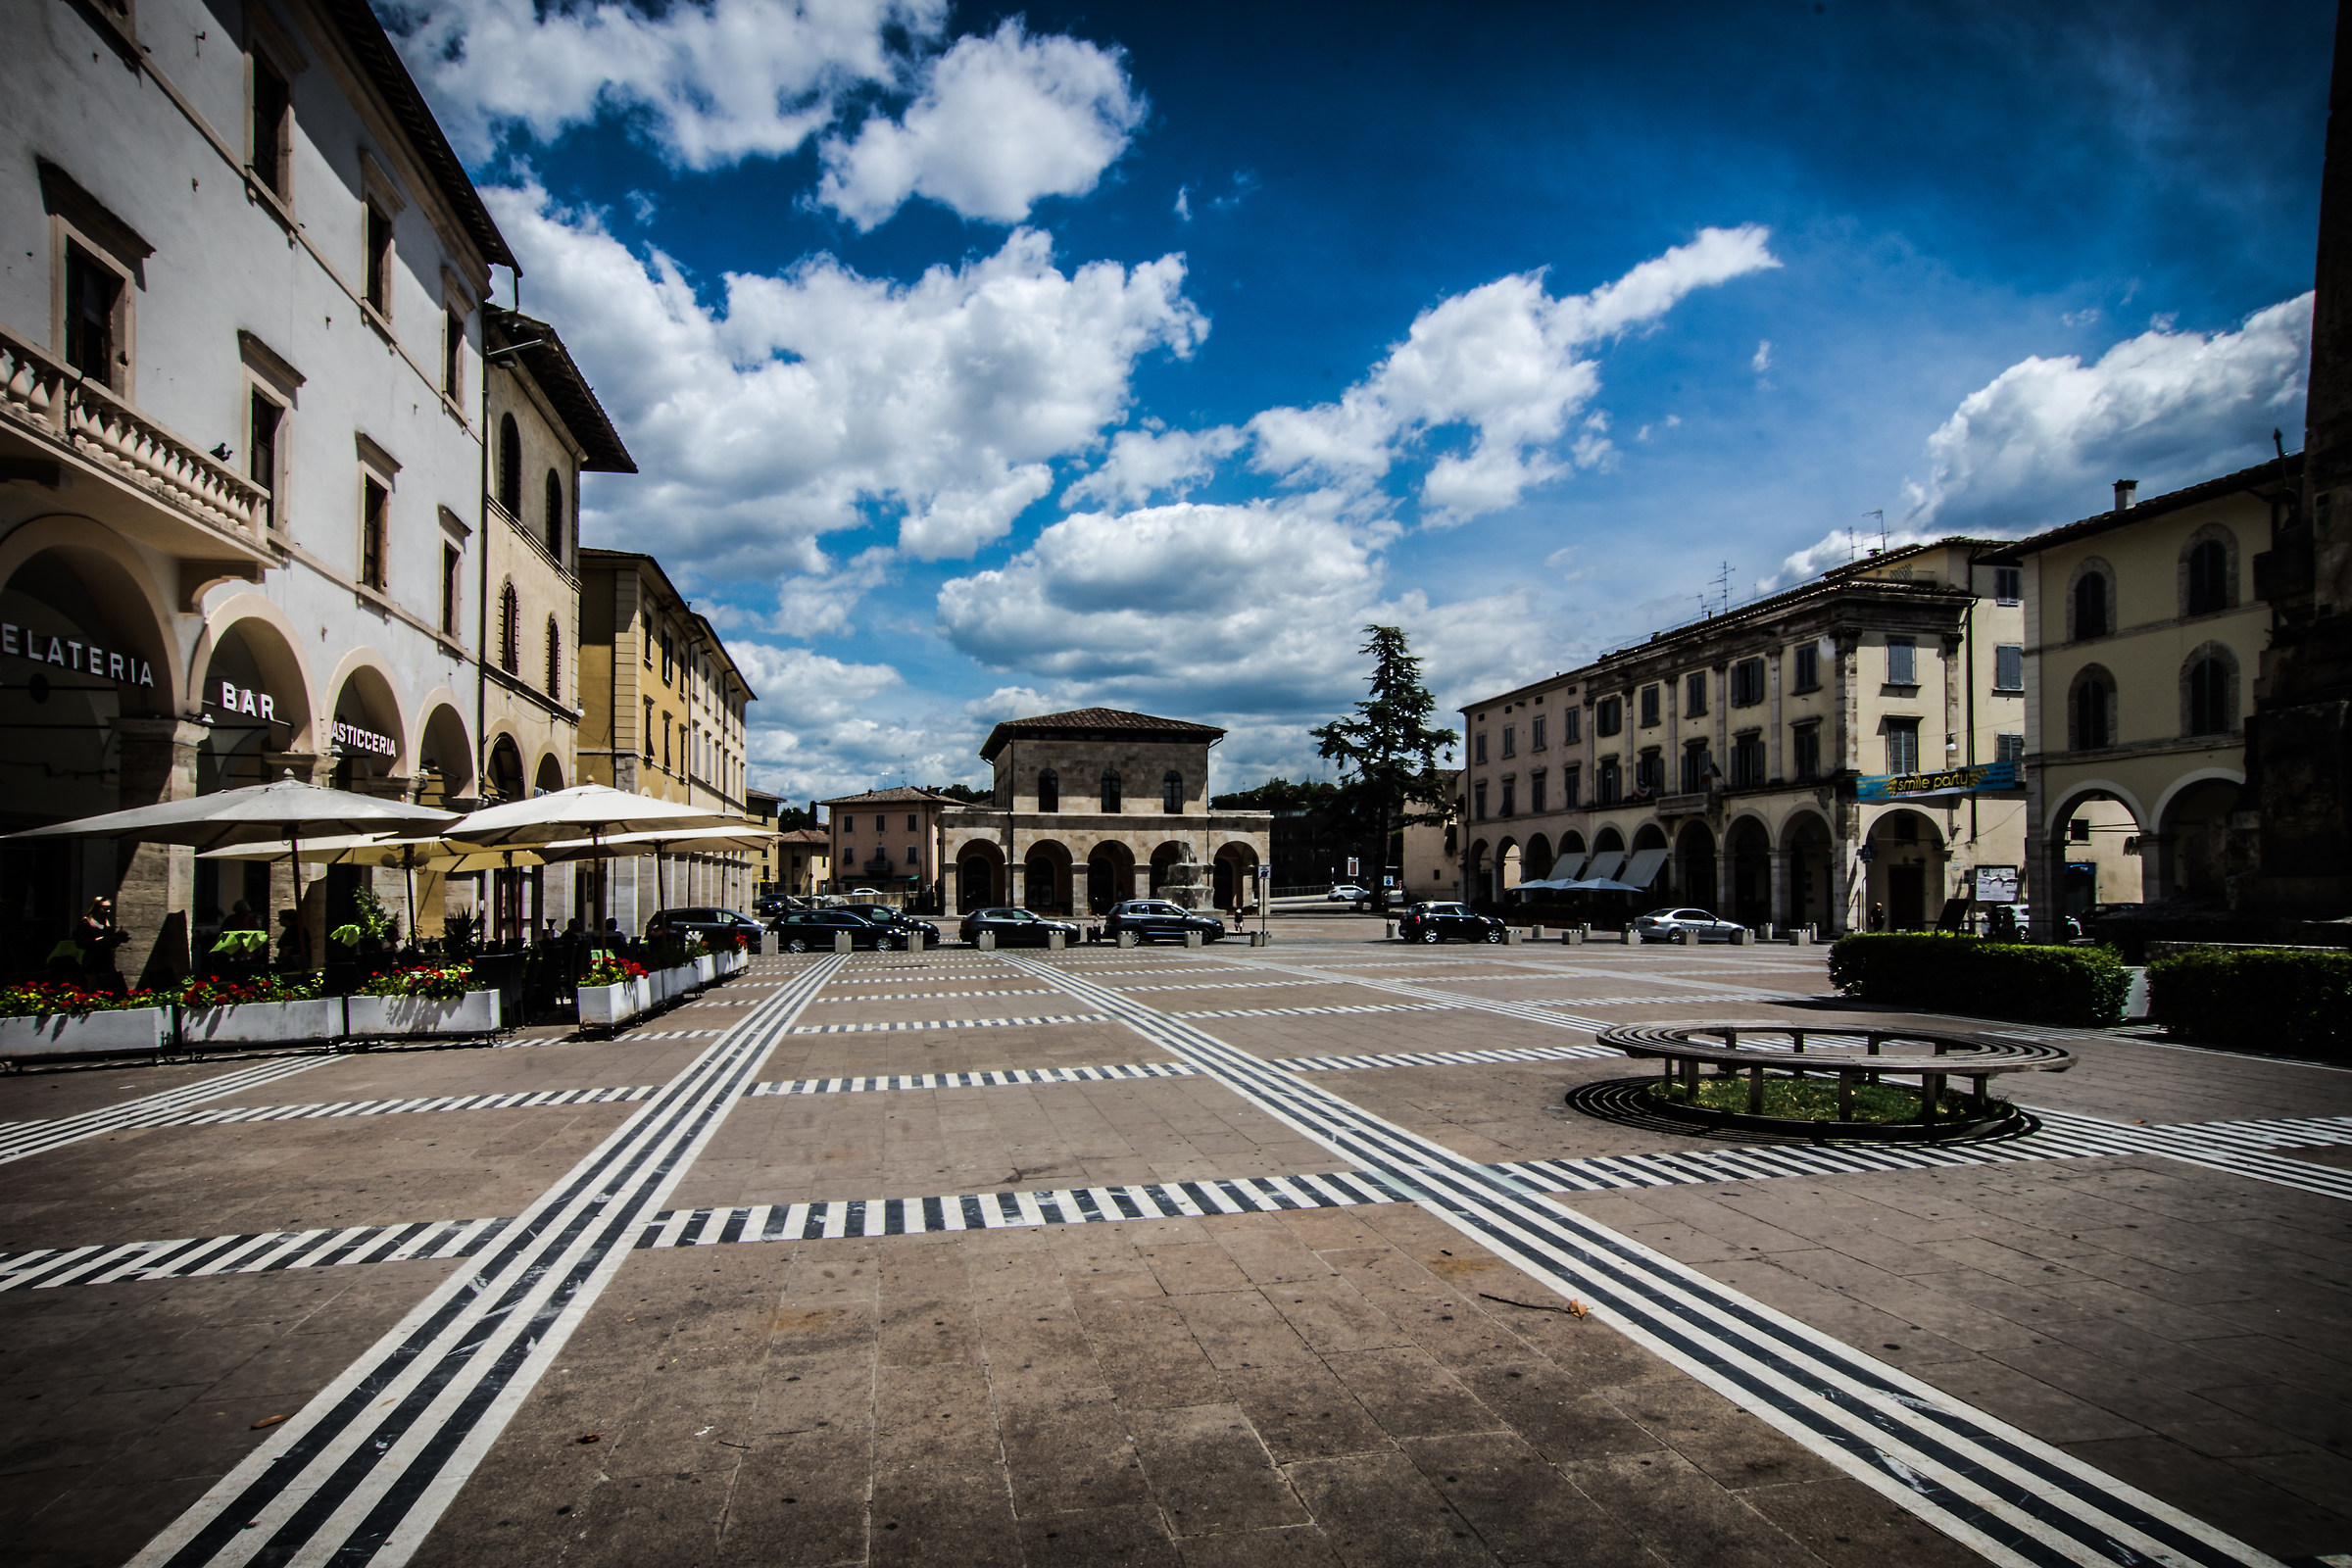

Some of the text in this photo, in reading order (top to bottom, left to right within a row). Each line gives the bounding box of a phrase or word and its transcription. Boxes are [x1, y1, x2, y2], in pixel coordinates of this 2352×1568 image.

[1, 622, 154, 687] ELATERIA
[221, 681, 275, 720] BAR
[331, 720, 397, 758] ASTICCERIA
[1897, 772, 1969, 793] smile party
